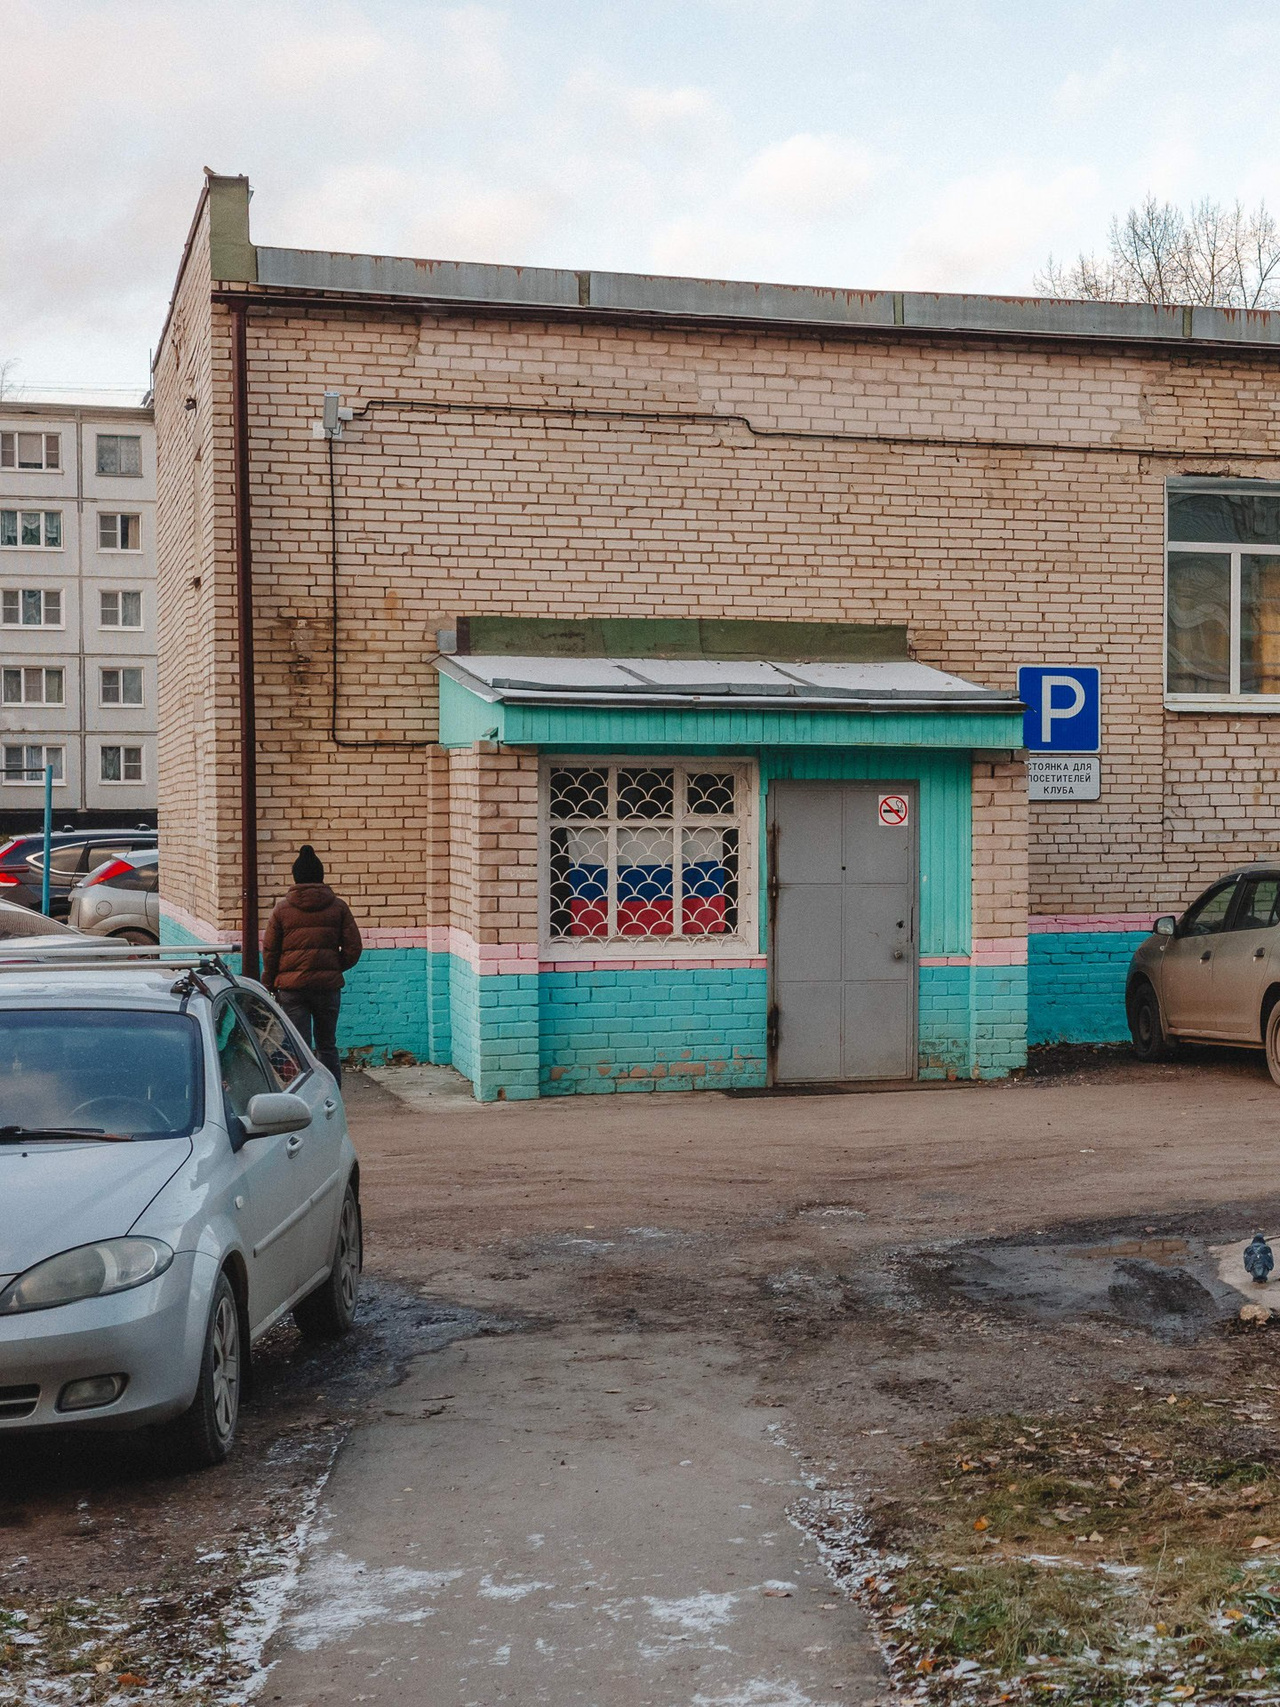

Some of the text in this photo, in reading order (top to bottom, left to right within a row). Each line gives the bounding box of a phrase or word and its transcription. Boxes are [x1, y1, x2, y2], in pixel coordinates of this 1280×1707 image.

[1041, 675, 1086, 742] P
[1073, 763, 1092, 771] ДЛЯ
[1043, 786, 1074, 794] КЛУБА
